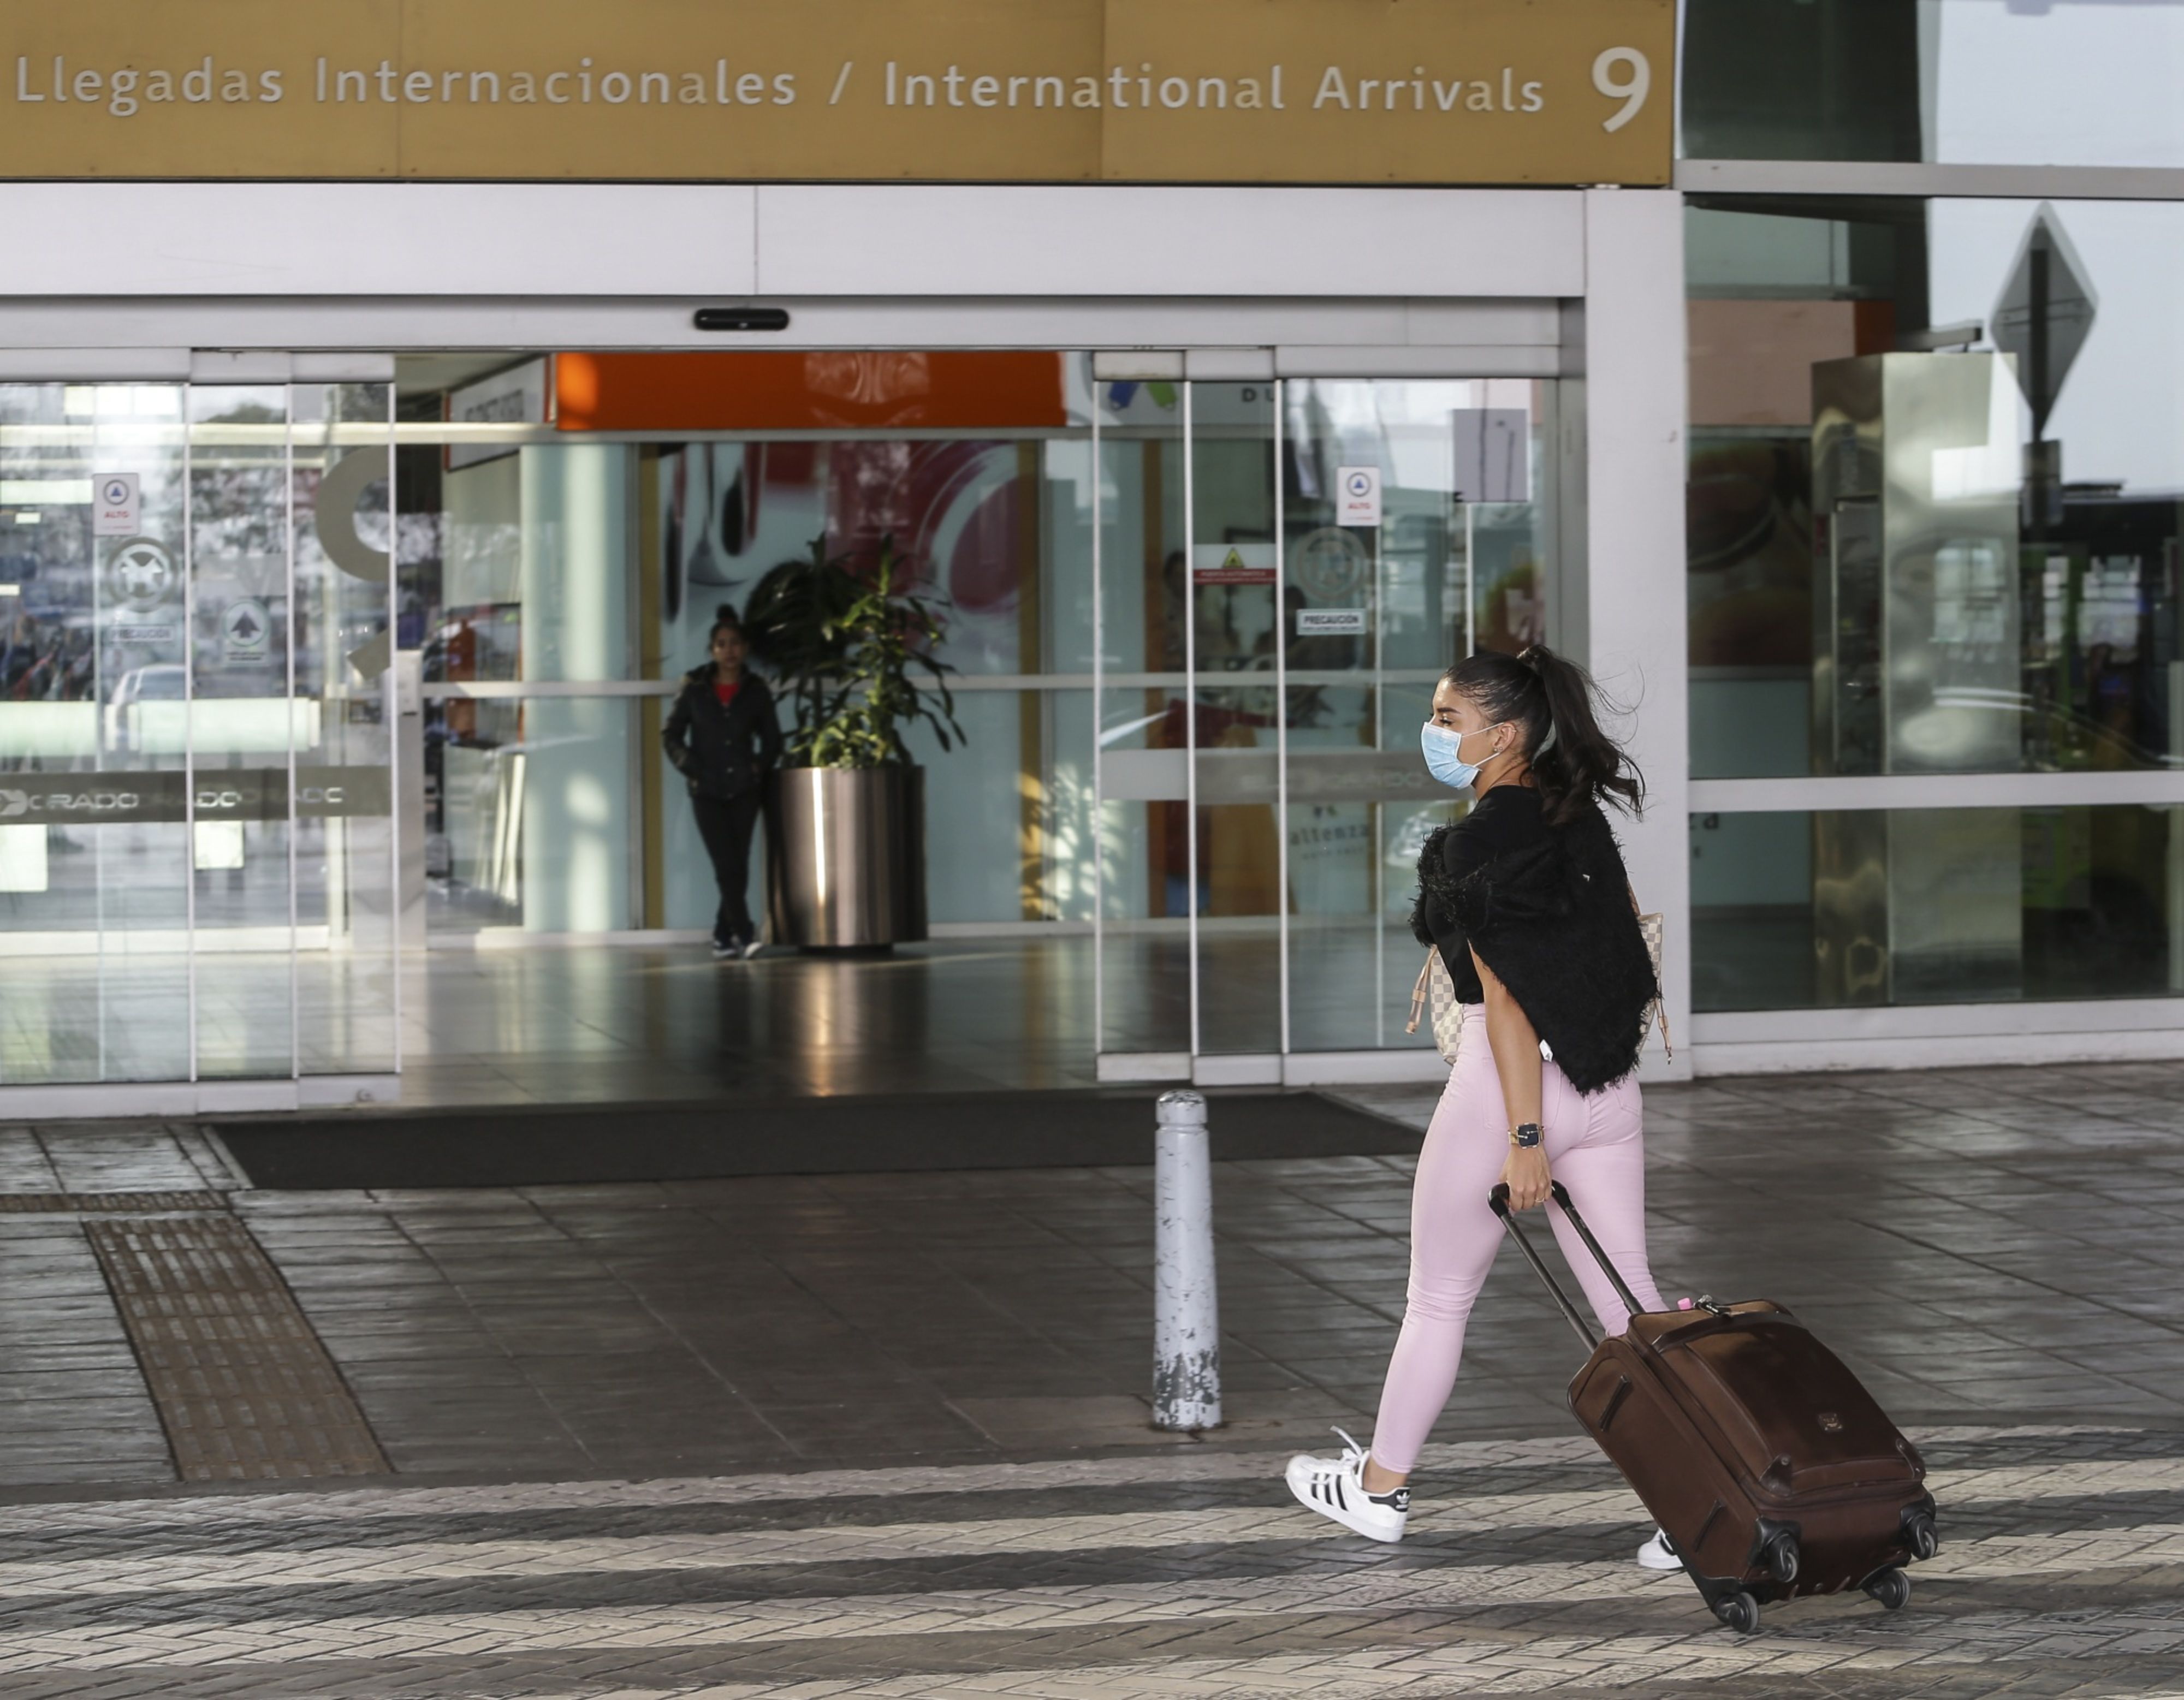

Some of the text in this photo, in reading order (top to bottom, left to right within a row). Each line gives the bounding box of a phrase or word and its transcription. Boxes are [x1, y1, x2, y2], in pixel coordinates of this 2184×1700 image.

[16, 46, 1651, 133] Llegadas Internacionales / International Arrivals 9
